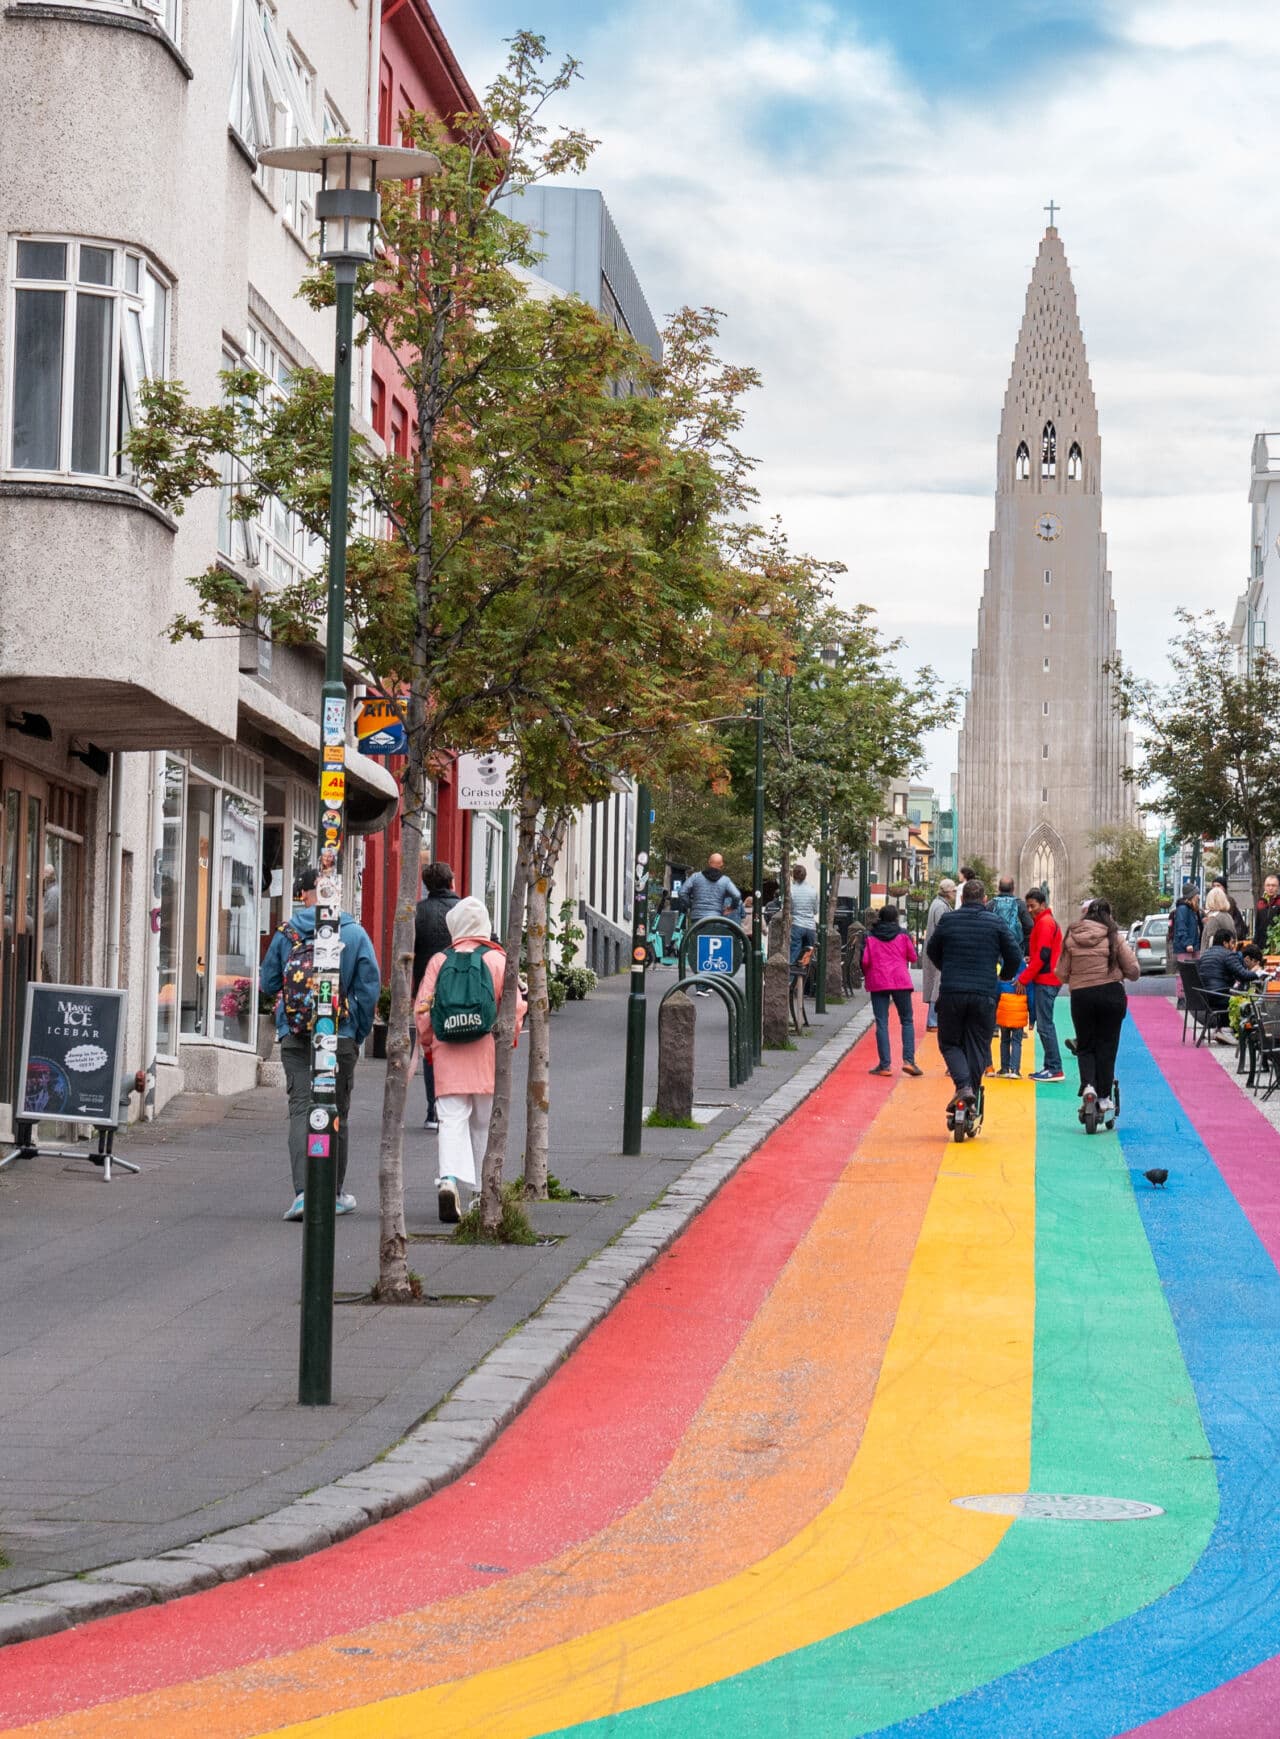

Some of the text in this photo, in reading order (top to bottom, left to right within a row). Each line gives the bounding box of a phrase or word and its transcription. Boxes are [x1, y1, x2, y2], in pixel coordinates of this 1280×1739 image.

[709, 938, 722, 955] P
[58, 1001, 93, 1014] Magic
[63, 1011, 92, 1026] ICE
[443, 1013, 482, 1030] ADIDAS
[47, 1026, 100, 1038] ICEBAR
